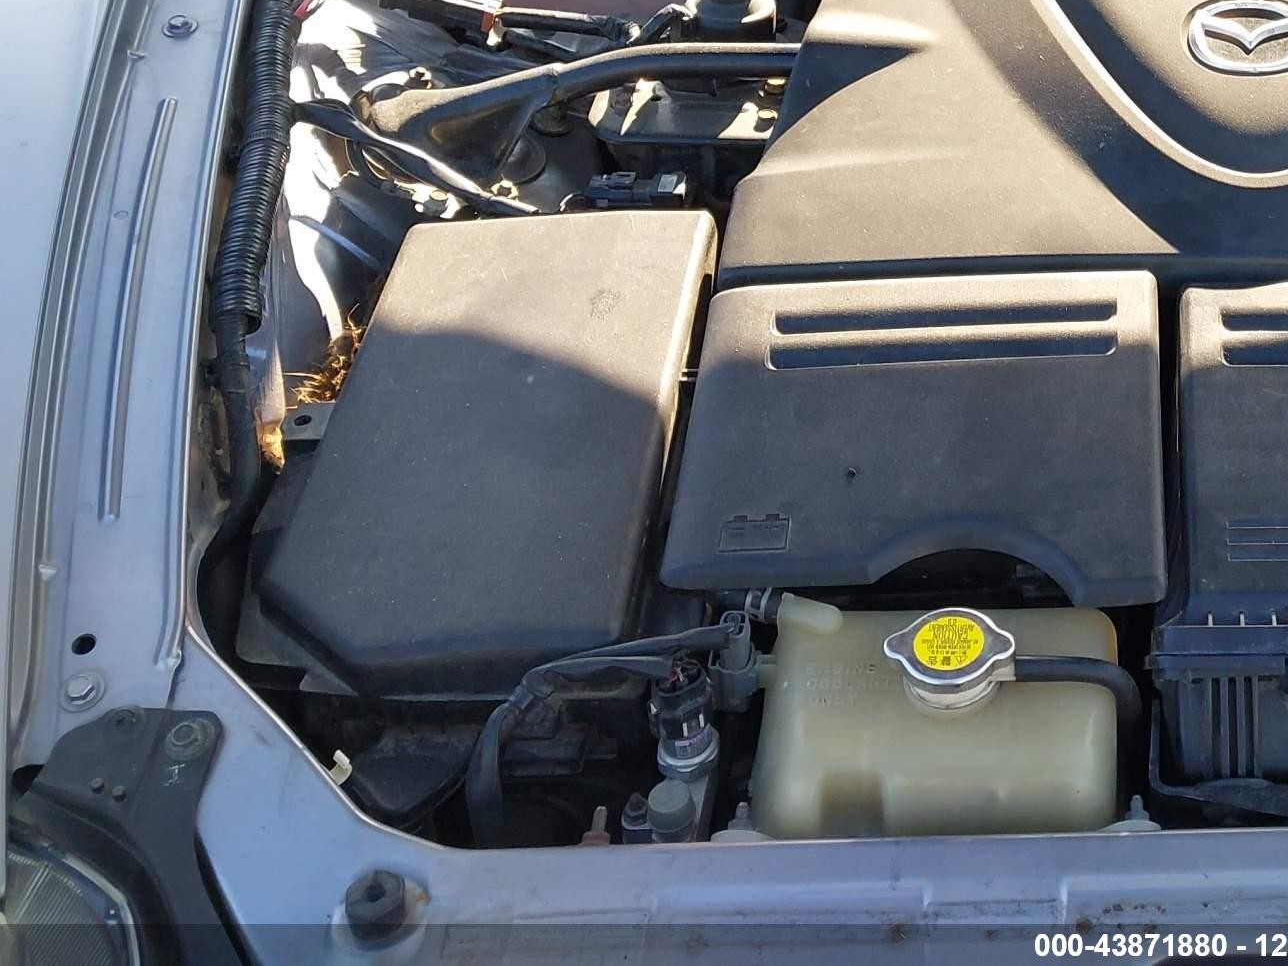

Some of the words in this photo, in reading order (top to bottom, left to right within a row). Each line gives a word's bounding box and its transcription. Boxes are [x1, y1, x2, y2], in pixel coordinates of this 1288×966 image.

[932, 631, 969, 640] CAUTION
[806, 663, 877, 675] ENGINE
[806, 677, 892, 690] COOLANT
[807, 693, 858, 706] ONLY
